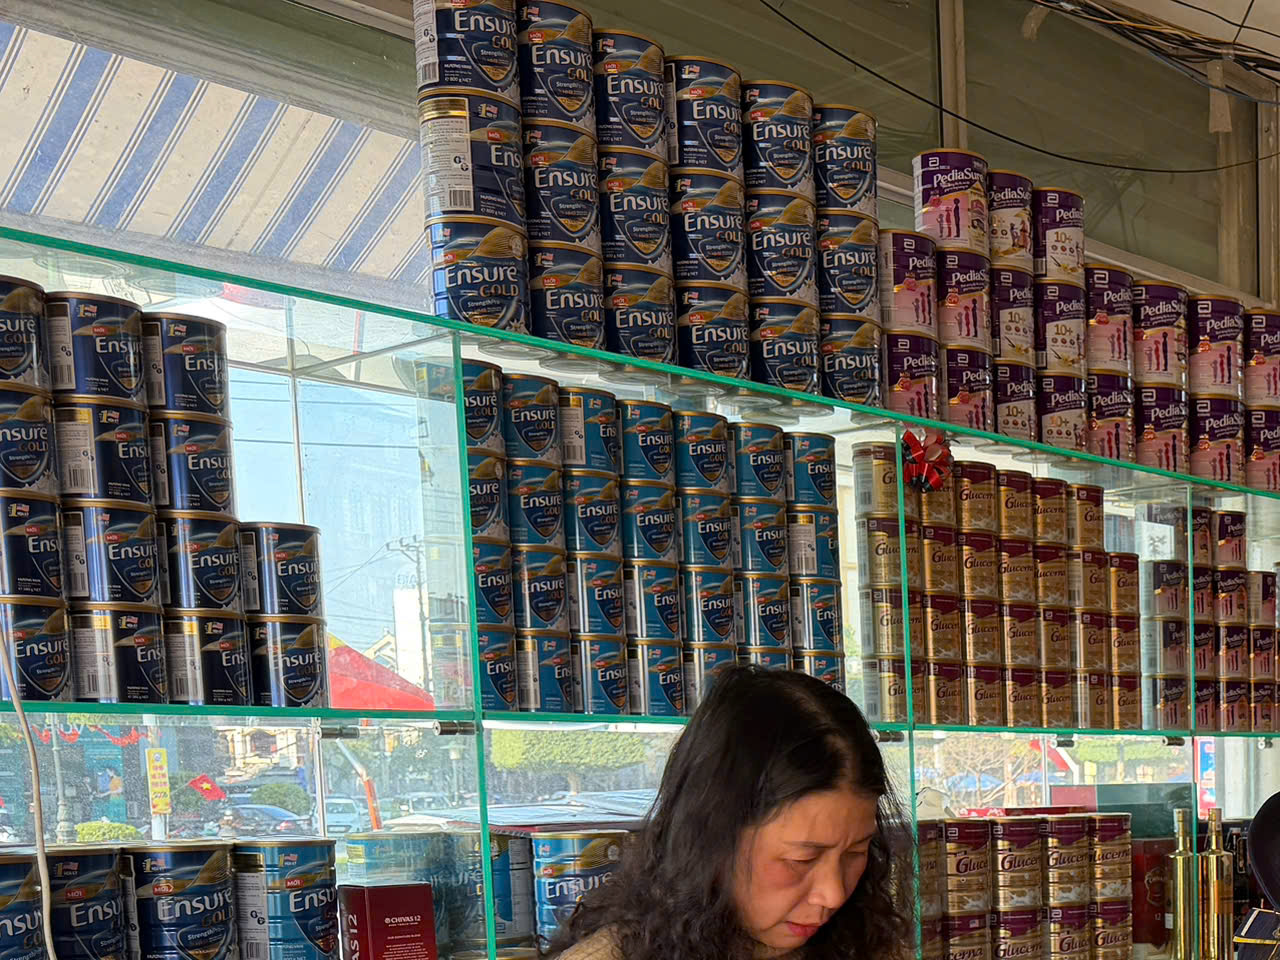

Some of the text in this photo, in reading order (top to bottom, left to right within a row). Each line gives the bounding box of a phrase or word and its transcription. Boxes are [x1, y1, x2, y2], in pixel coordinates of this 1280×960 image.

[753, 122, 811, 141] Ensure
[784, 139, 810, 152] GOLD
[815, 144, 872, 163] Ensure
[842, 160, 871, 172] GOLD
[685, 212, 743, 232] Ensure
[752, 231, 811, 251] Ensure
[782, 247, 811, 259] GOLD
[823, 250, 876, 269] Ensure
[445, 265, 518, 288] Ensure
[480, 284, 519, 298] GOLD
[824, 353, 878, 373] Ensure
[512, 408, 556, 423] Ensure
[157, 886, 233, 920] Ensure
[348, 914, 358, 934] 12
[391, 915, 414, 923] CHIVAS
